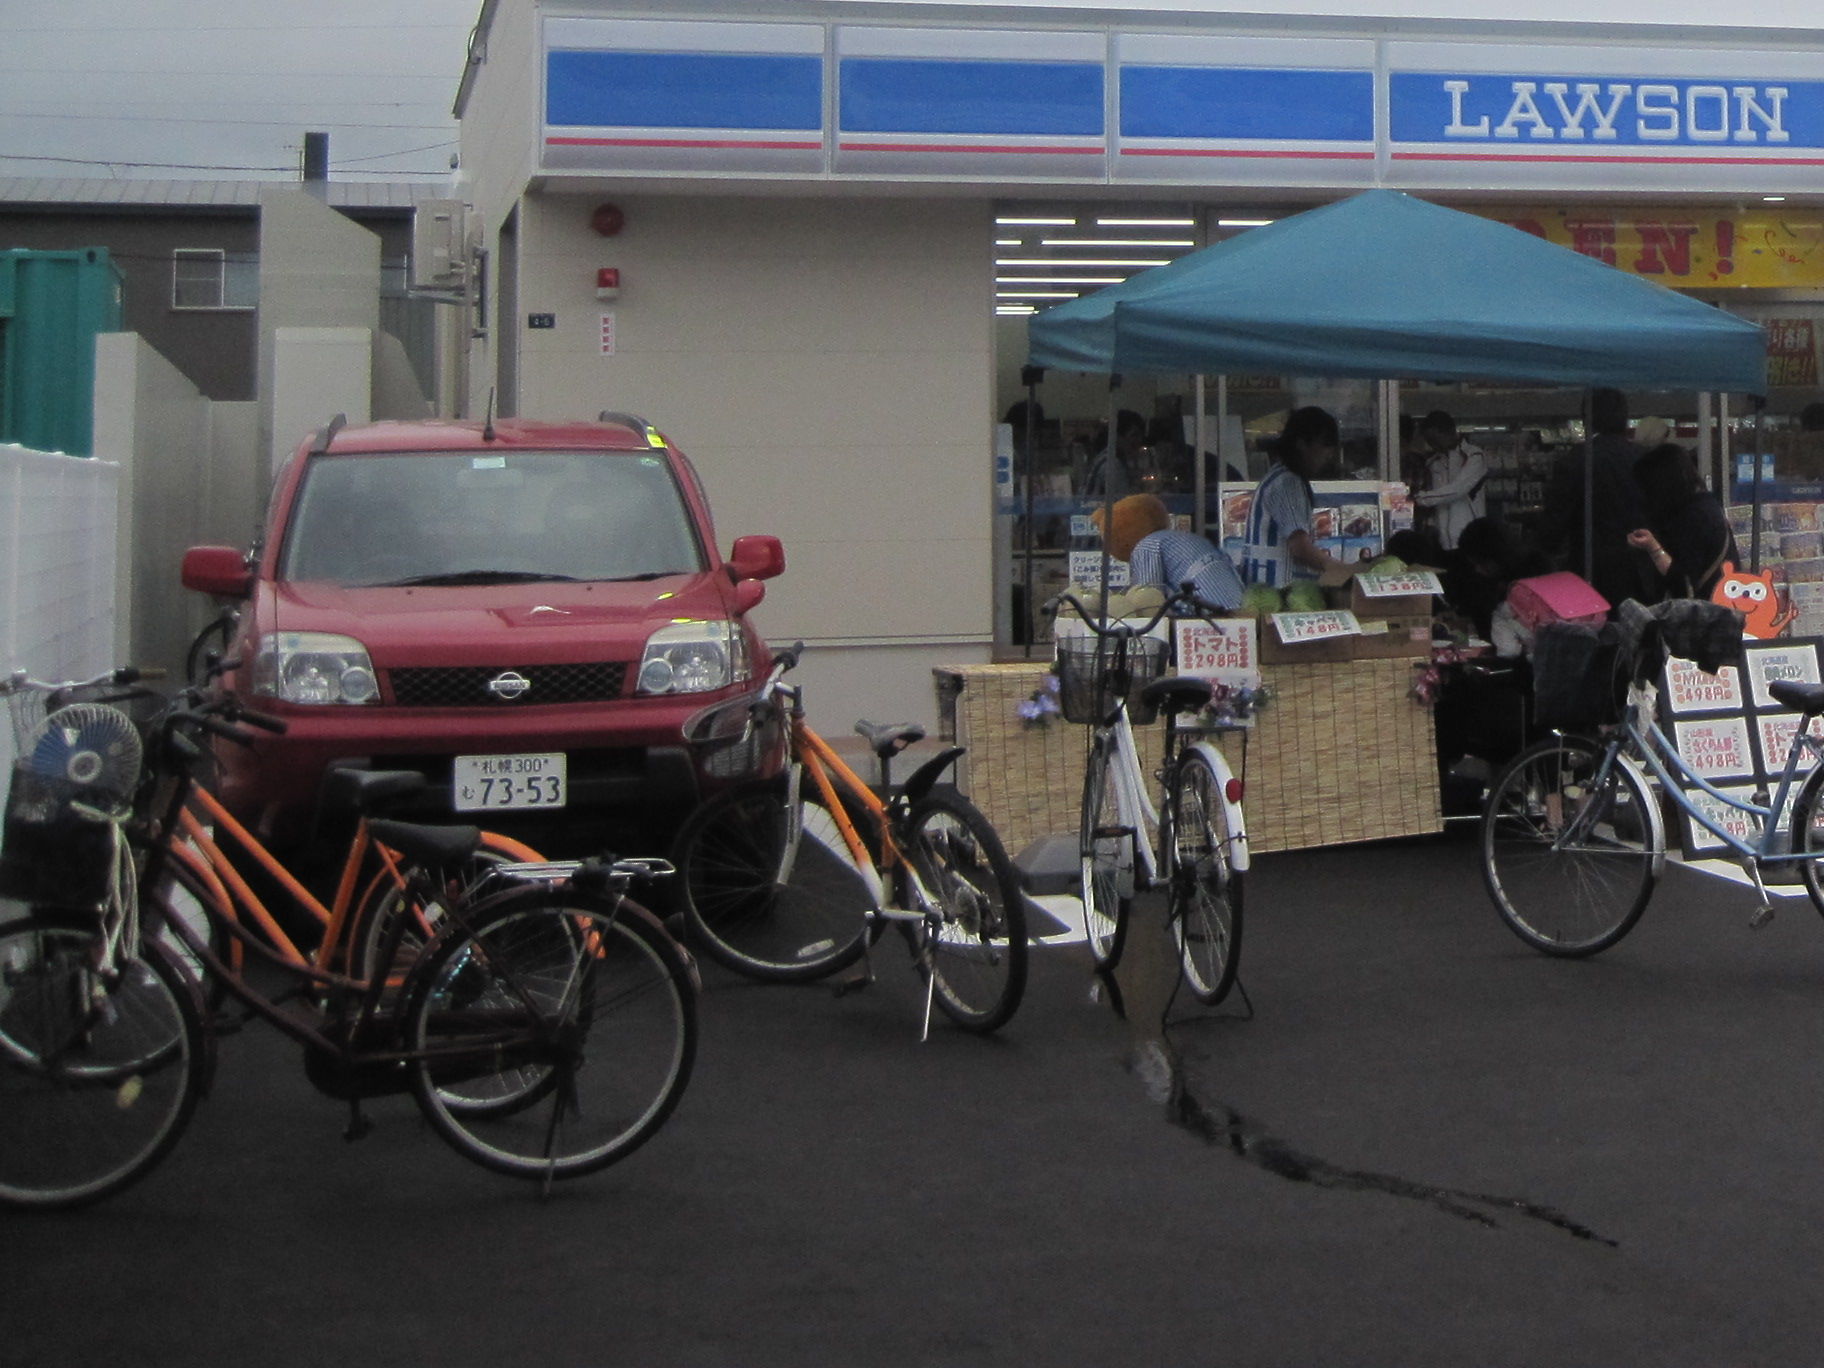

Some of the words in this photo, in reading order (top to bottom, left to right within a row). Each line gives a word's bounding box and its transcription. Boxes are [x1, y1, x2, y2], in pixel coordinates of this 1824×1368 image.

[1443, 79, 1790, 143] LAWSON
[1502, 219, 1734, 275] EN!
[1194, 637, 1238, 652] トマト
[1195, 653, 1238, 668] 298円
[1686, 686, 1724, 702] 498円
[1696, 752, 1737, 769] 498円
[481, 776, 560, 805] 73-53
